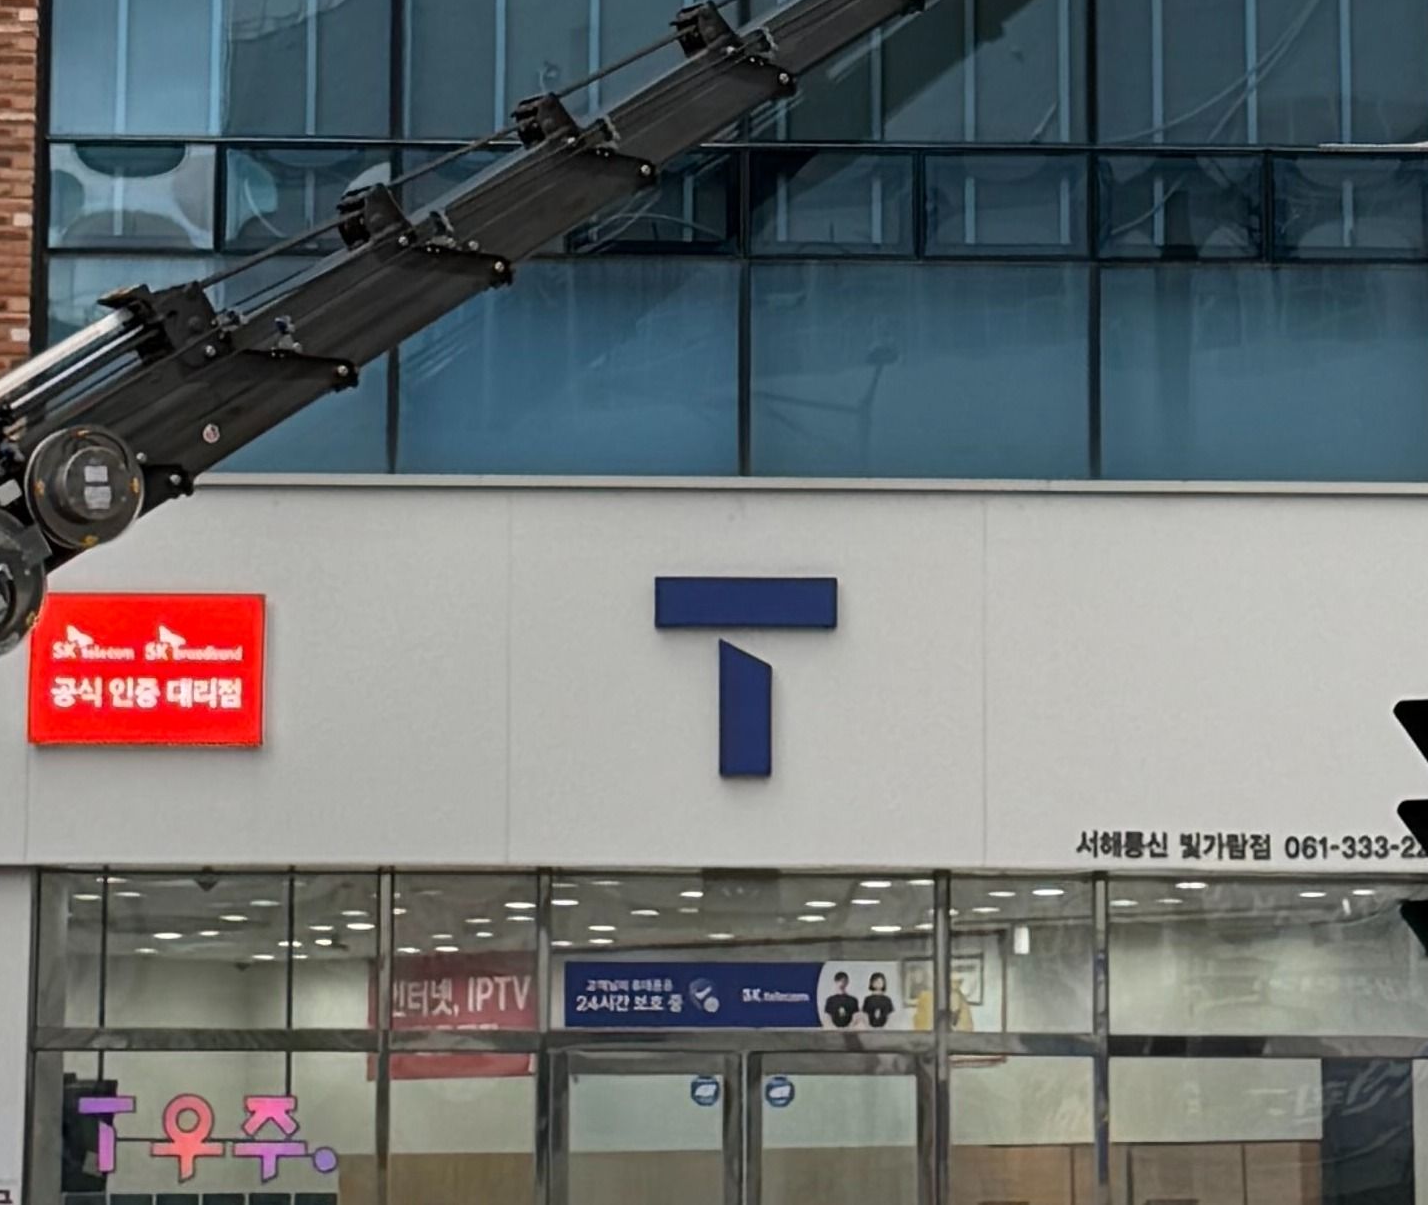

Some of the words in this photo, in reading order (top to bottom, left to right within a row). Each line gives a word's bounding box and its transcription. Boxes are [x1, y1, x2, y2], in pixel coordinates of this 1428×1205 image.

[51, 676, 103, 709] 공식
[109, 676, 161, 709] 인증
[166, 676, 243, 709] 대리점
[1076, 829, 1169, 860] 서해통신
[1179, 831, 1272, 861] 빛가람점
[1284, 835, 1428, 860] 061-333-2
[467, 974, 532, 1013] IPTV
